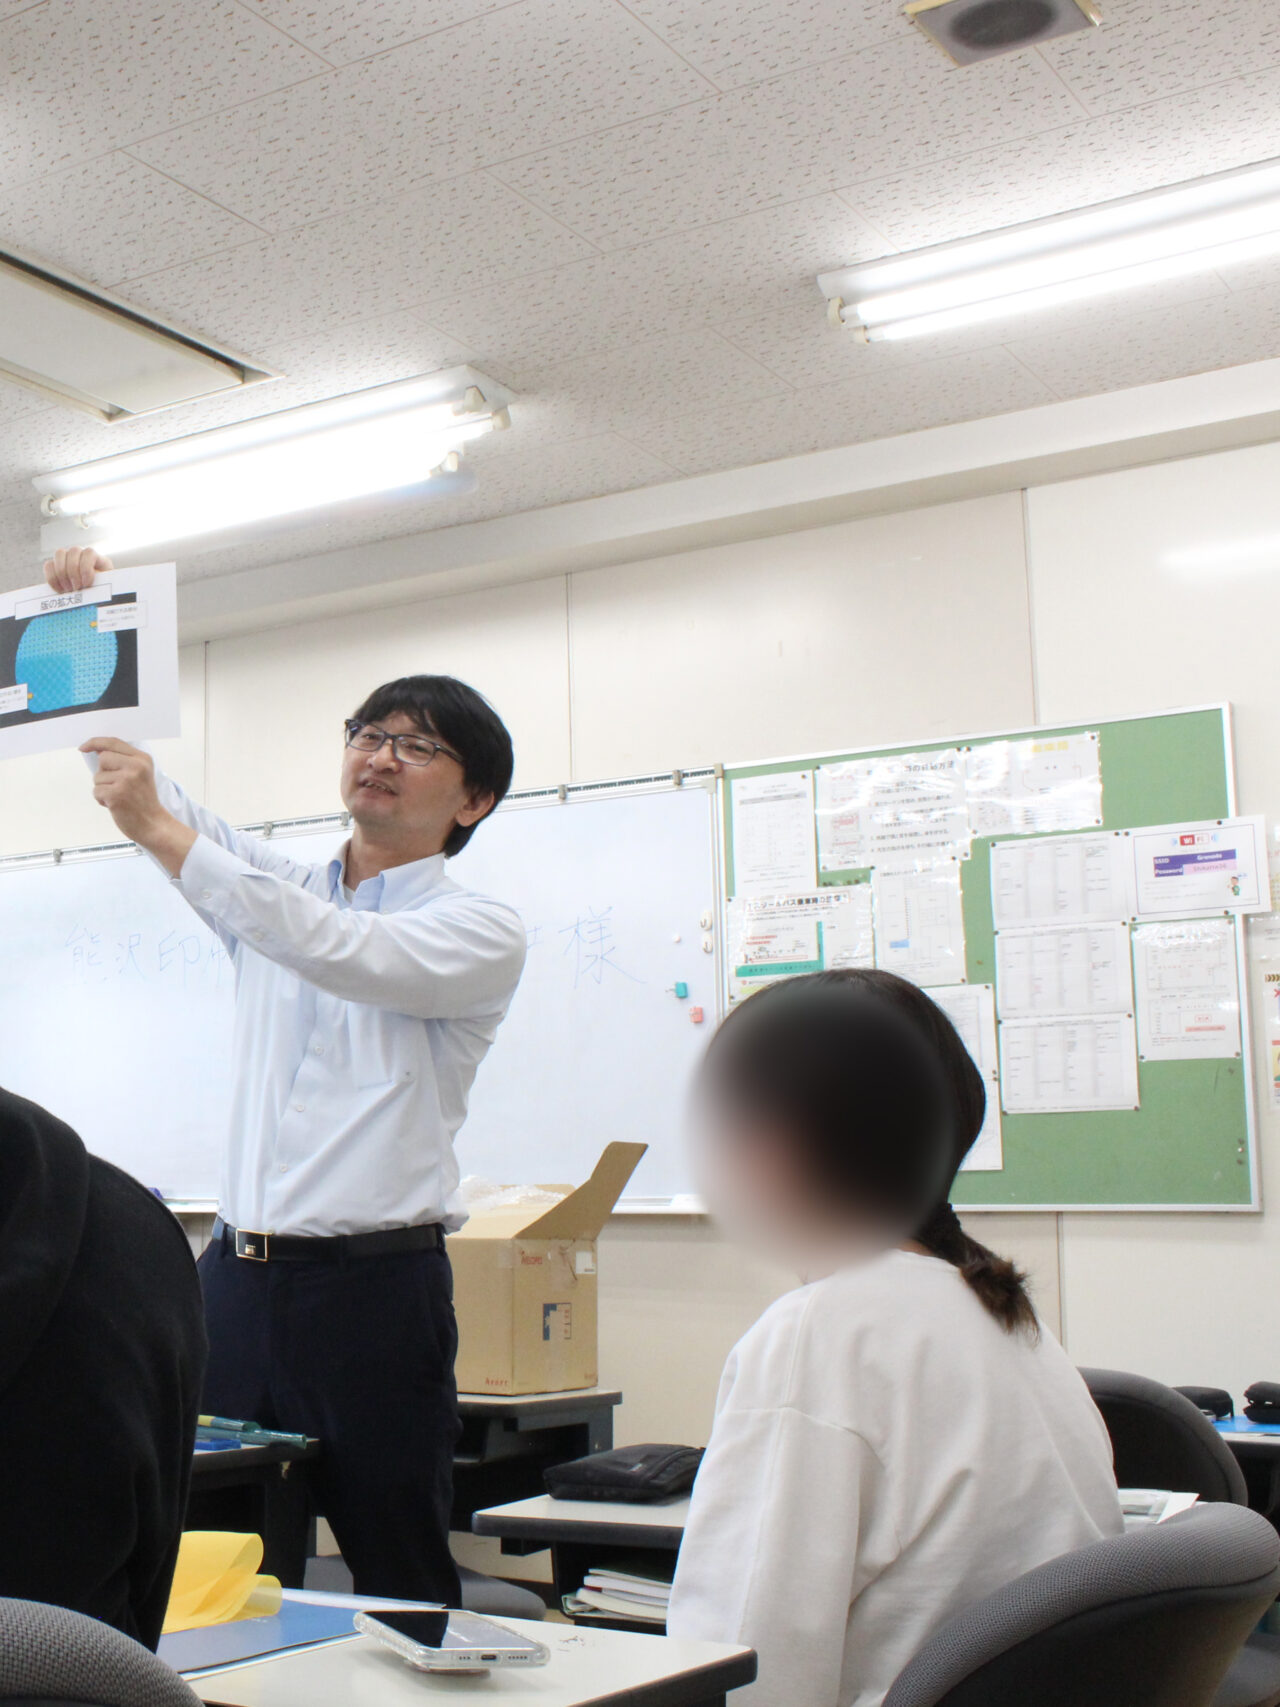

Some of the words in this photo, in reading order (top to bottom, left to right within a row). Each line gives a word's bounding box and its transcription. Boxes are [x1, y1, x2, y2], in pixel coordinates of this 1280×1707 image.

[40, 593, 83, 611] 版の拡大図
